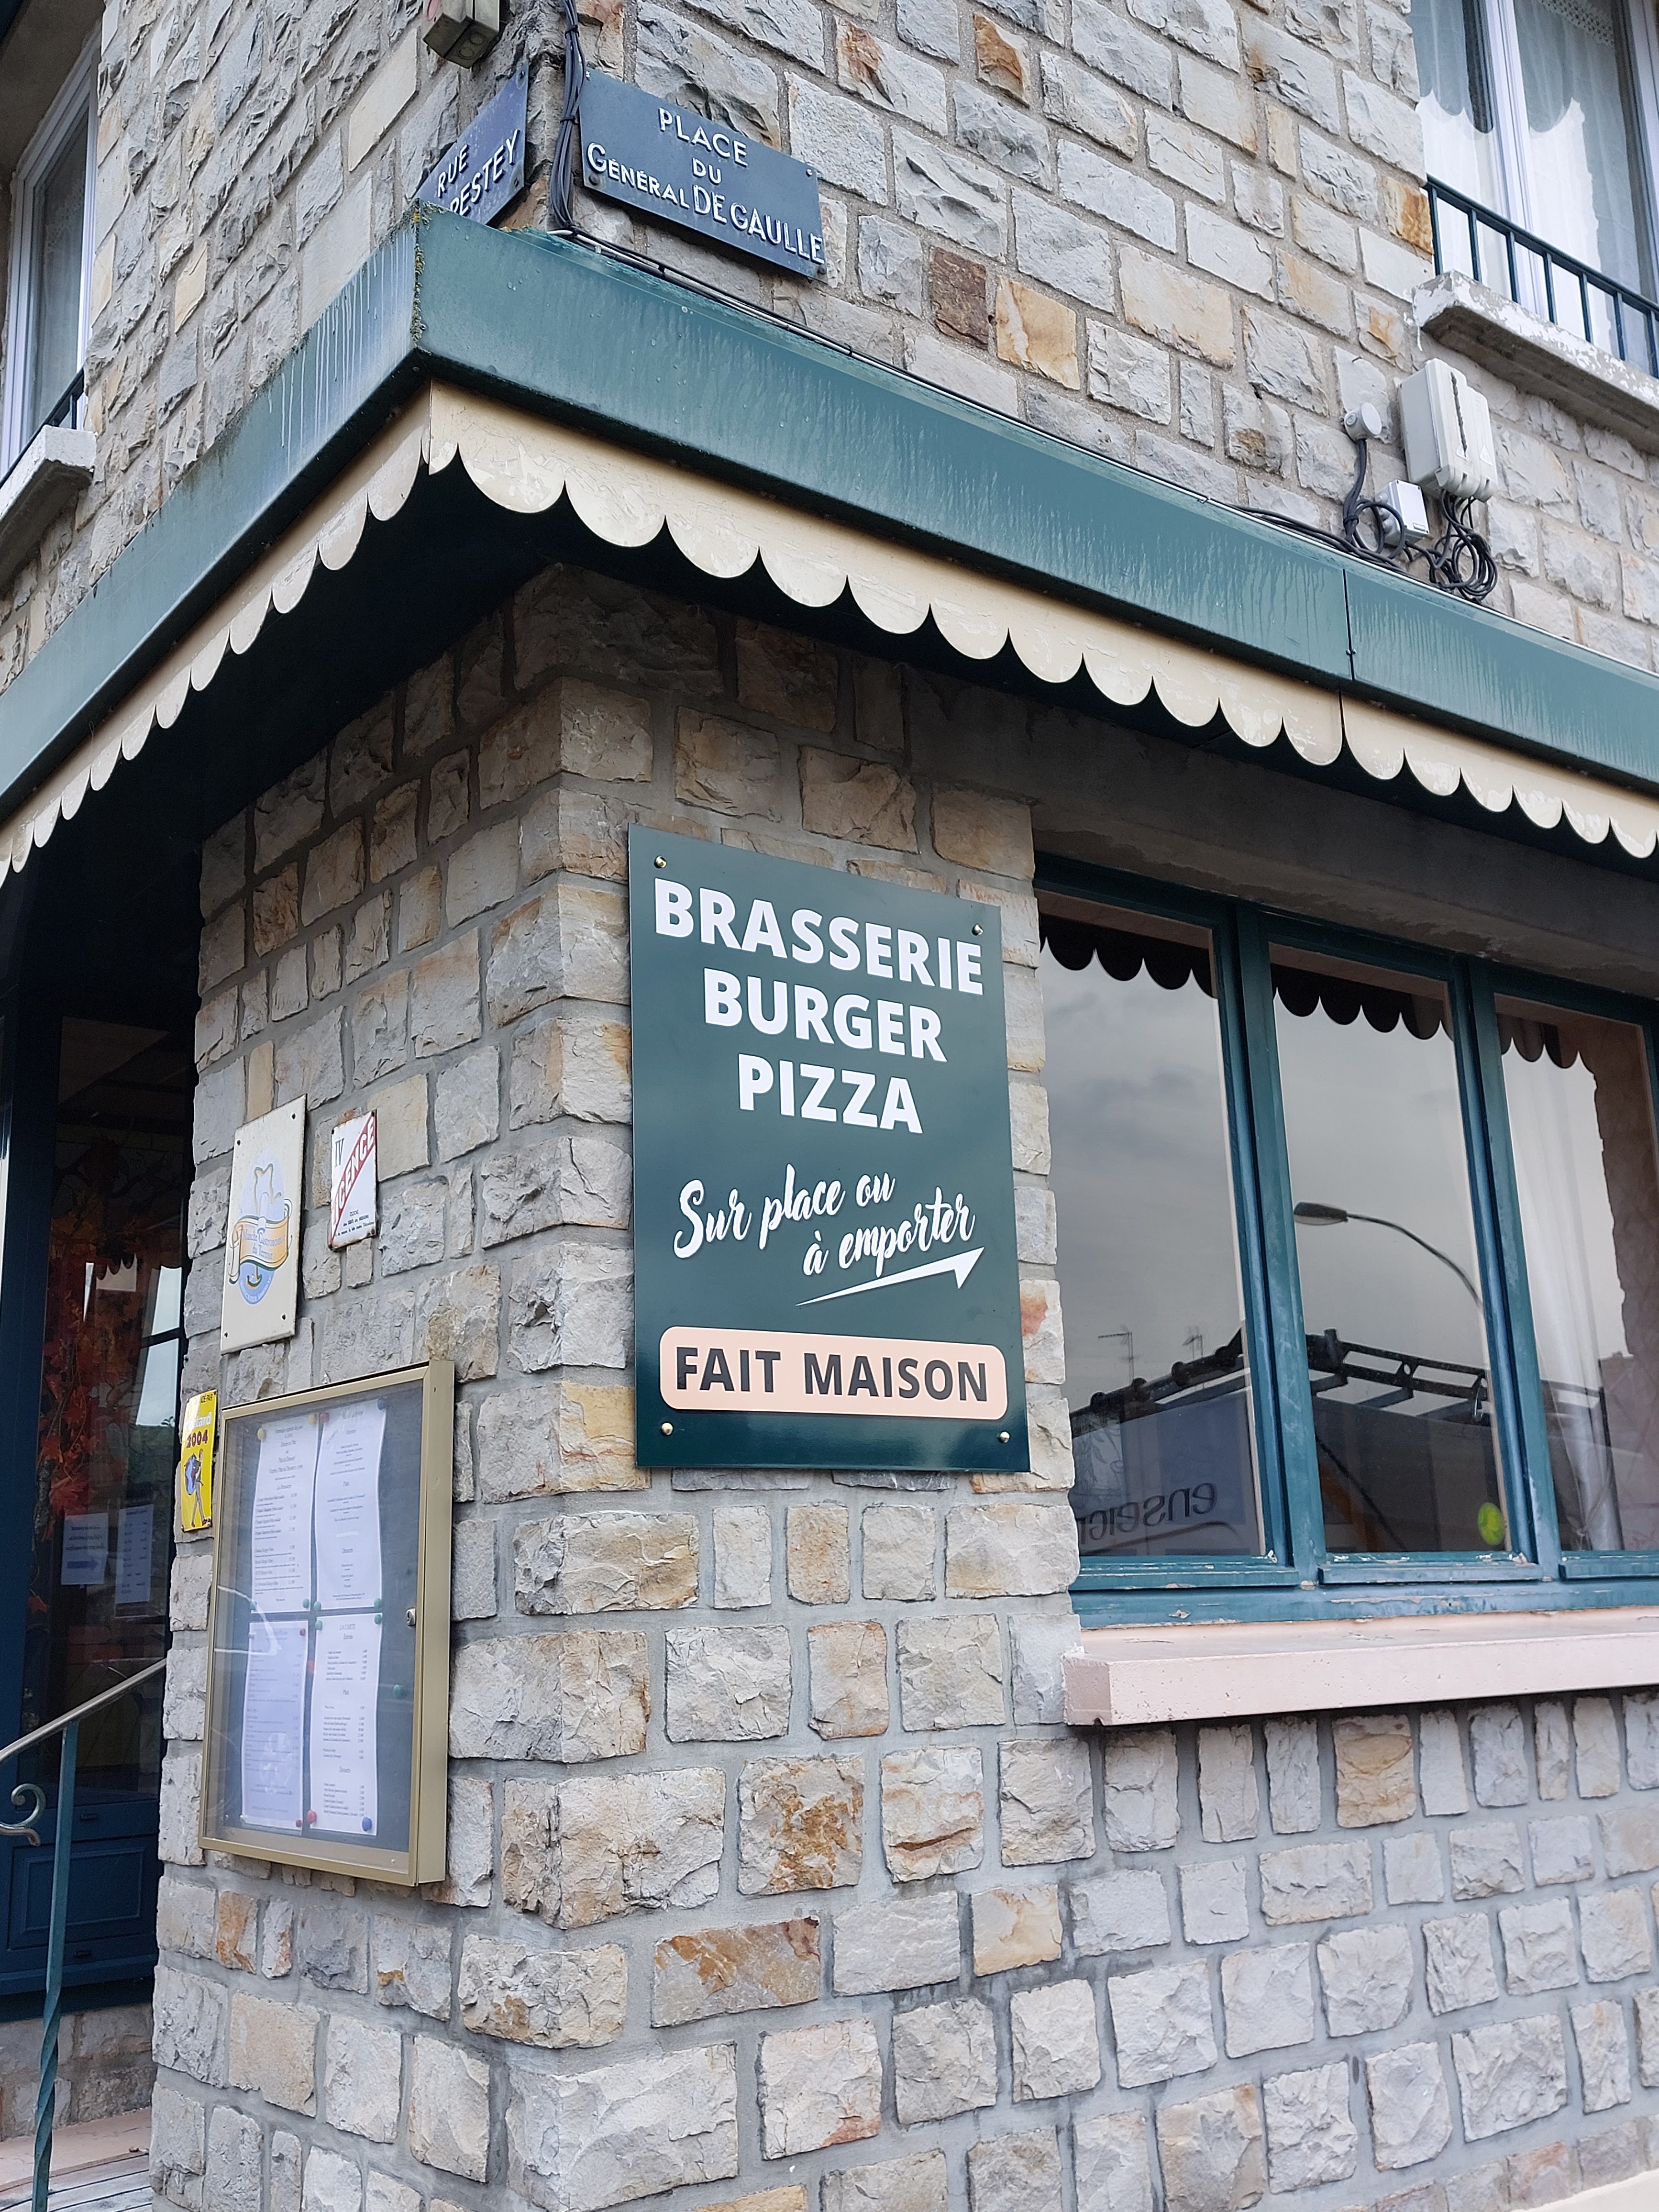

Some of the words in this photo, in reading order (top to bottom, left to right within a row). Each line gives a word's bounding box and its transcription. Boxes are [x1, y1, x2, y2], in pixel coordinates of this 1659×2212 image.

[438, 144, 467, 197] RUE
[659, 108, 748, 167] PLACE
[692, 157, 722, 185] DU
[694, 184, 727, 224] DE
[730, 202, 825, 265] GAULLE
[654, 877, 984, 996] BRASSERIE
[704, 967, 948, 1063] BURGER
[739, 1053, 923, 1134] PIZZA
[674, 1179, 752, 1259] Sur
[760, 1163, 846, 1250] place
[856, 1172, 896, 1206] ou
[803, 1230, 827, 1276] à
[838, 1186, 976, 1278] emporter
[676, 1346, 781, 1393] FAIT
[804, 1352, 988, 1402] MAISON
[186, 1429, 208, 1449] 2004
